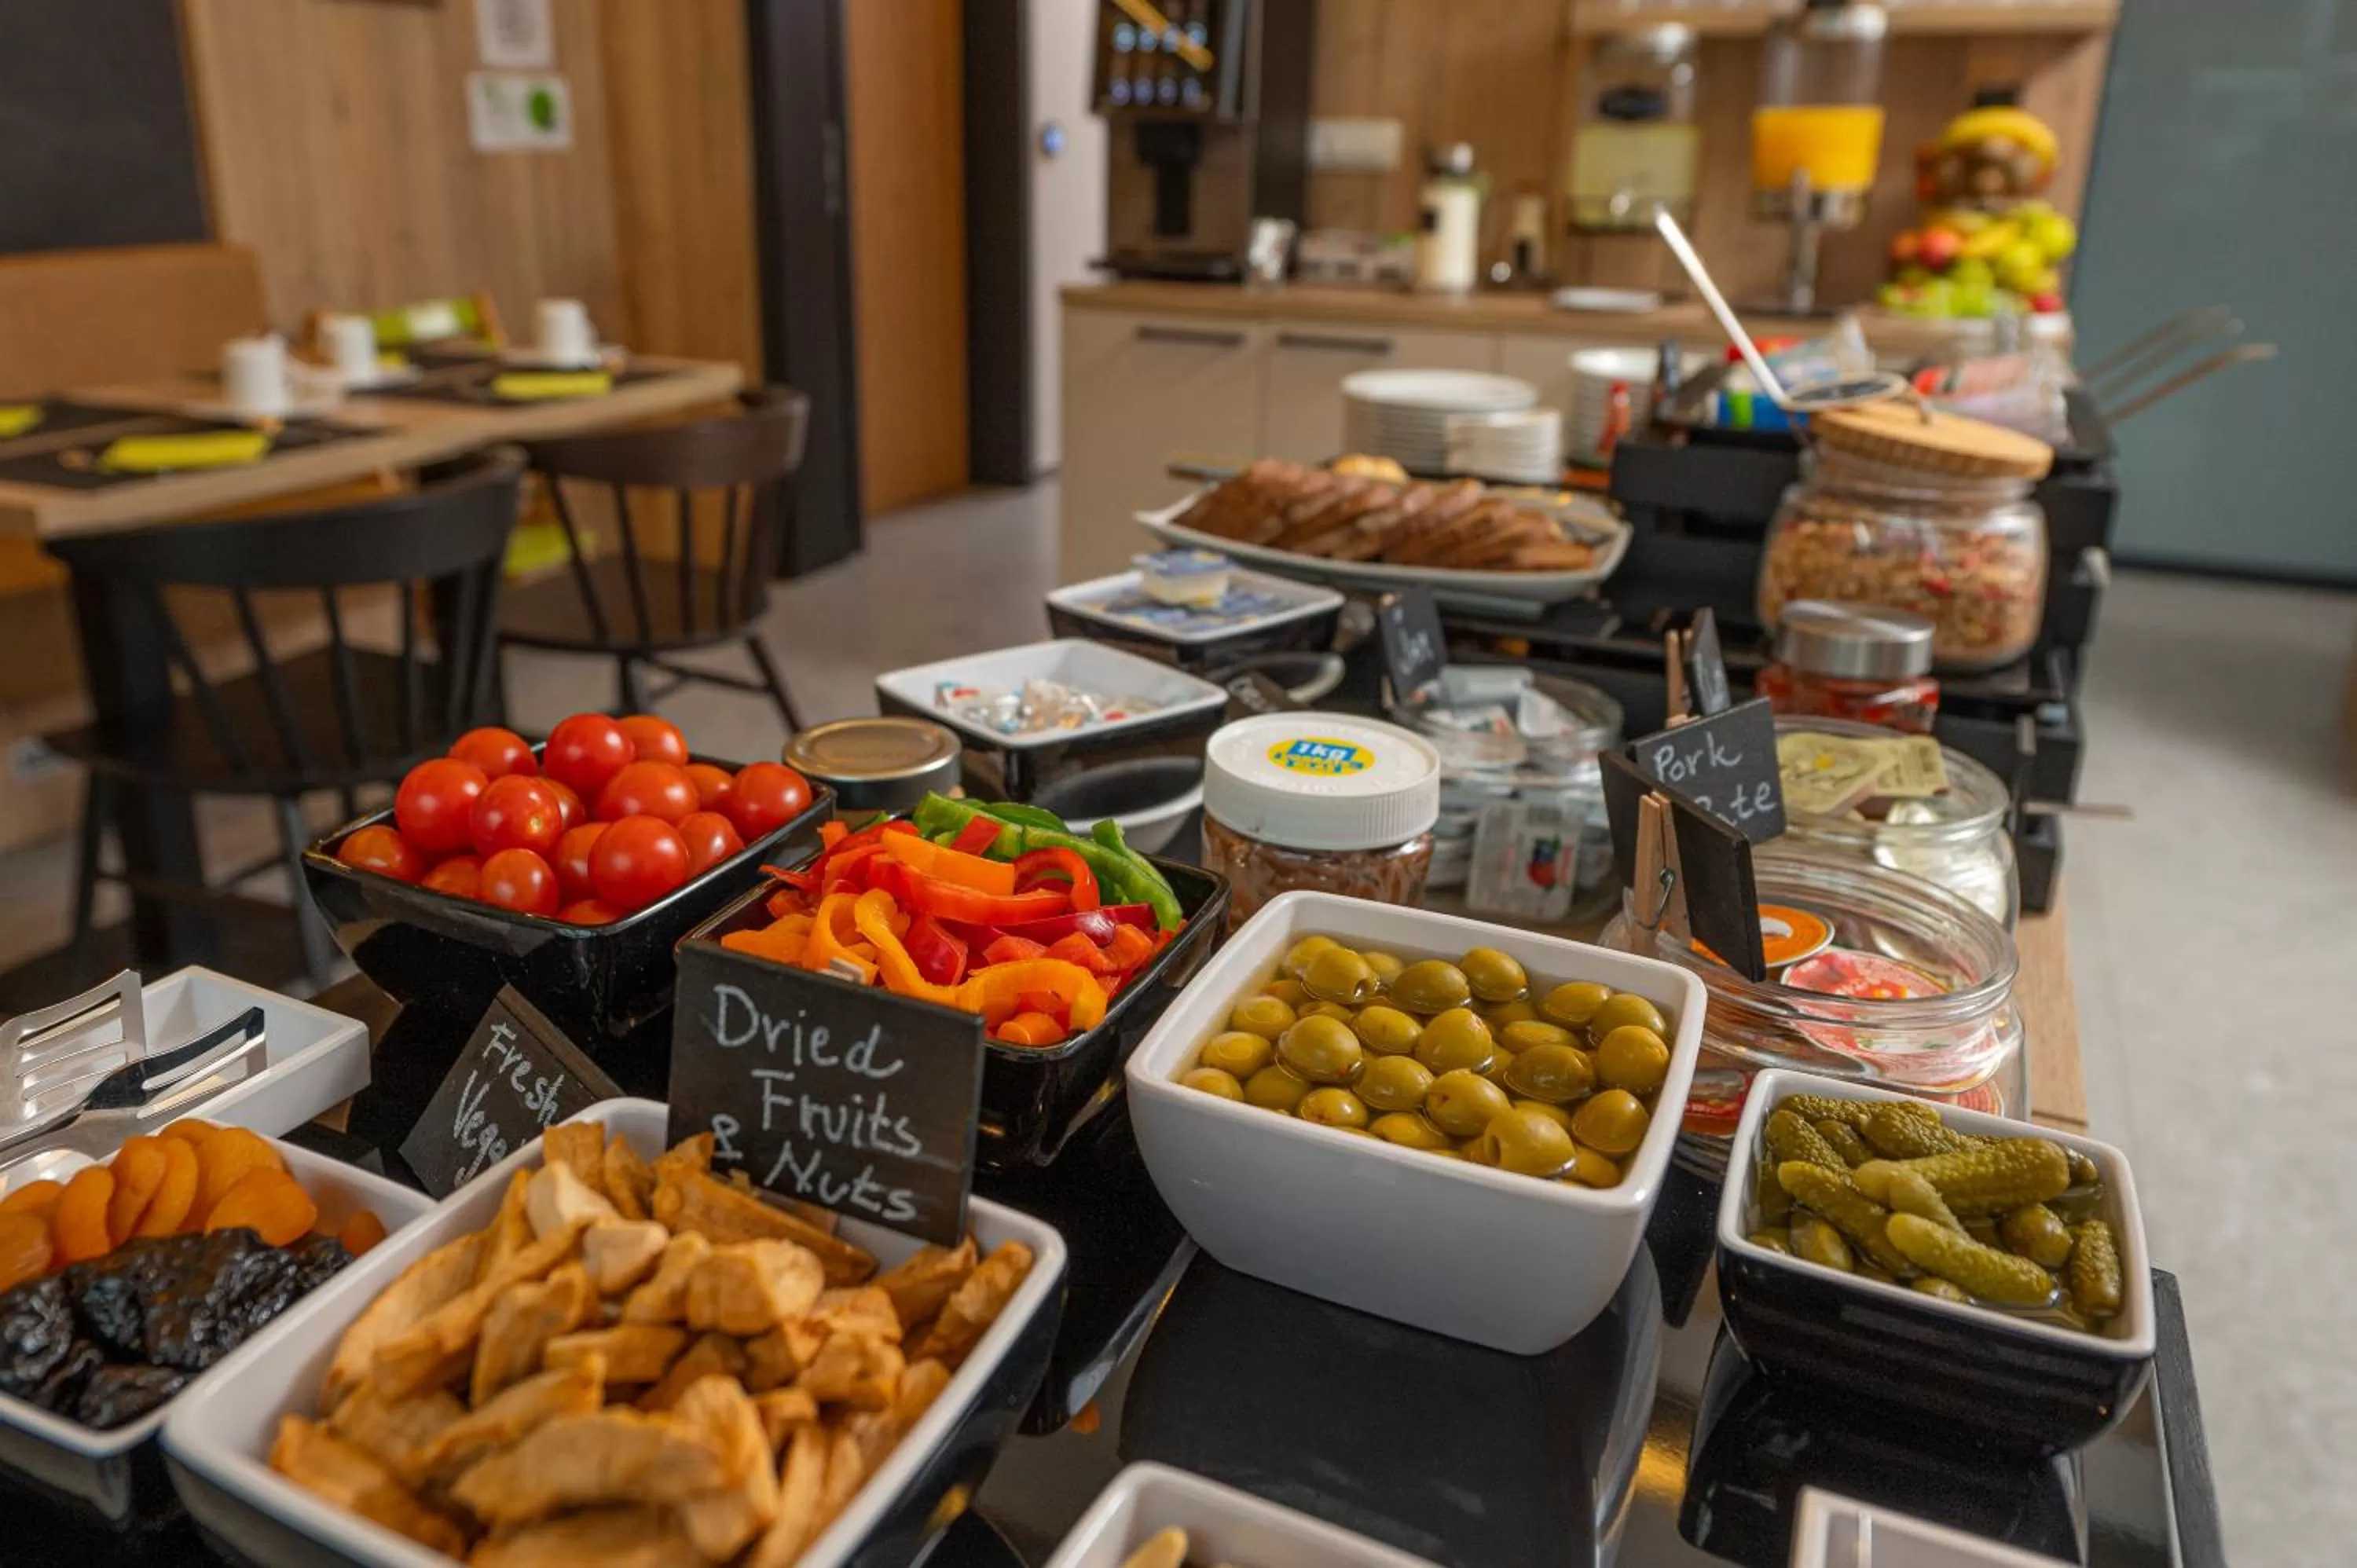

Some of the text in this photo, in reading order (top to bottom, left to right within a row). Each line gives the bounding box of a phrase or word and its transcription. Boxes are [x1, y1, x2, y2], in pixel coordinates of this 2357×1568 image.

[1653, 731, 1743, 783] Pork
[1694, 781, 1776, 827] te
[482, 1022, 565, 1127] Fresh
[714, 984, 903, 1079] Dried
[453, 1070, 526, 1189] Vege
[751, 1068, 922, 1156] Fruits
[711, 1114, 918, 1221] & Nuts
